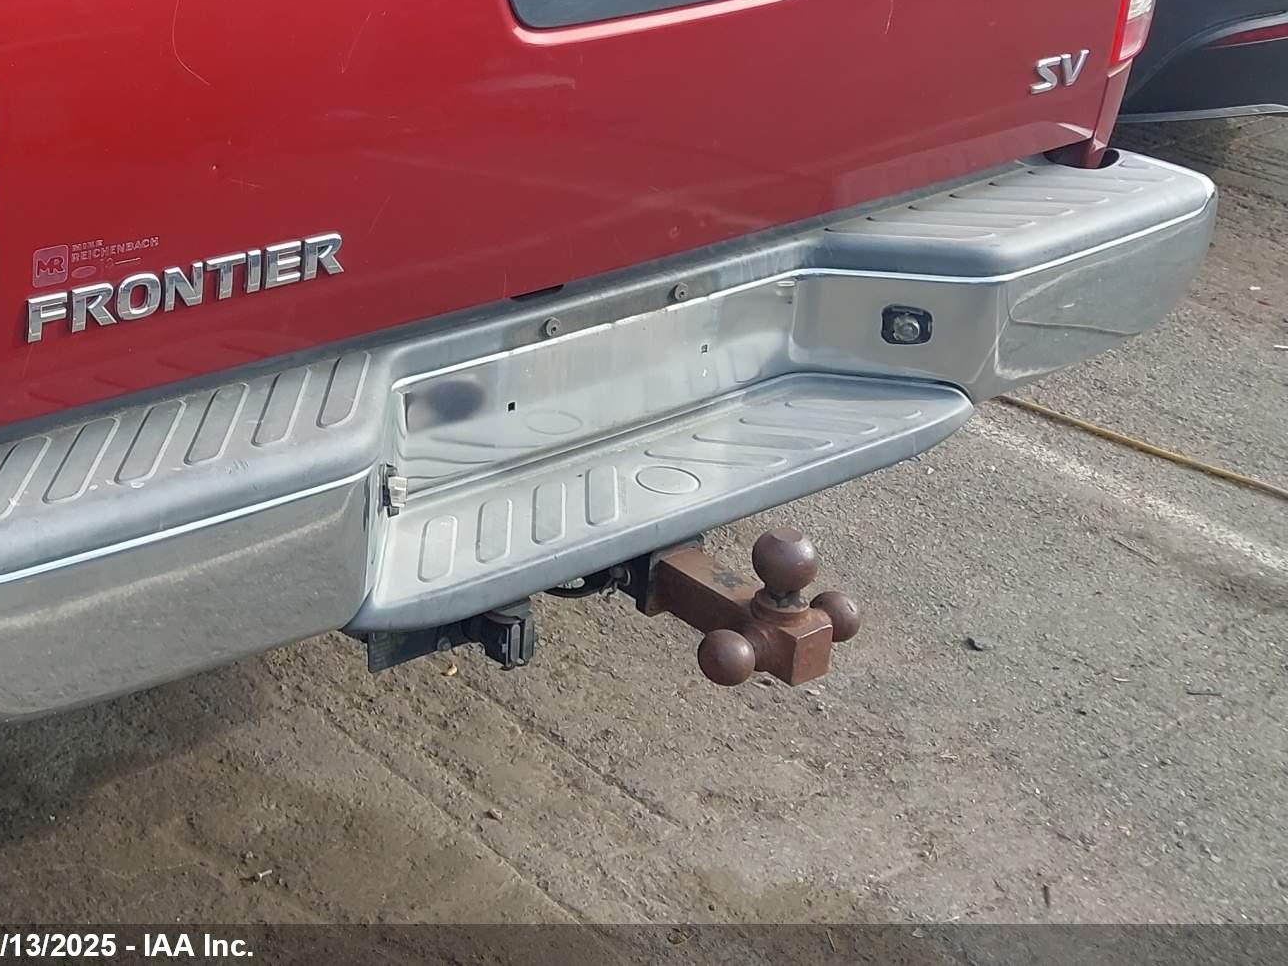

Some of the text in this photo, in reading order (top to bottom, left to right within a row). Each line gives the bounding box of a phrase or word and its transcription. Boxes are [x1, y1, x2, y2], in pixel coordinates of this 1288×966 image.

[1030, 49, 1090, 94] SV
[71, 236, 160, 263] REICHENBACH
[26, 232, 344, 343] FRONTIER
